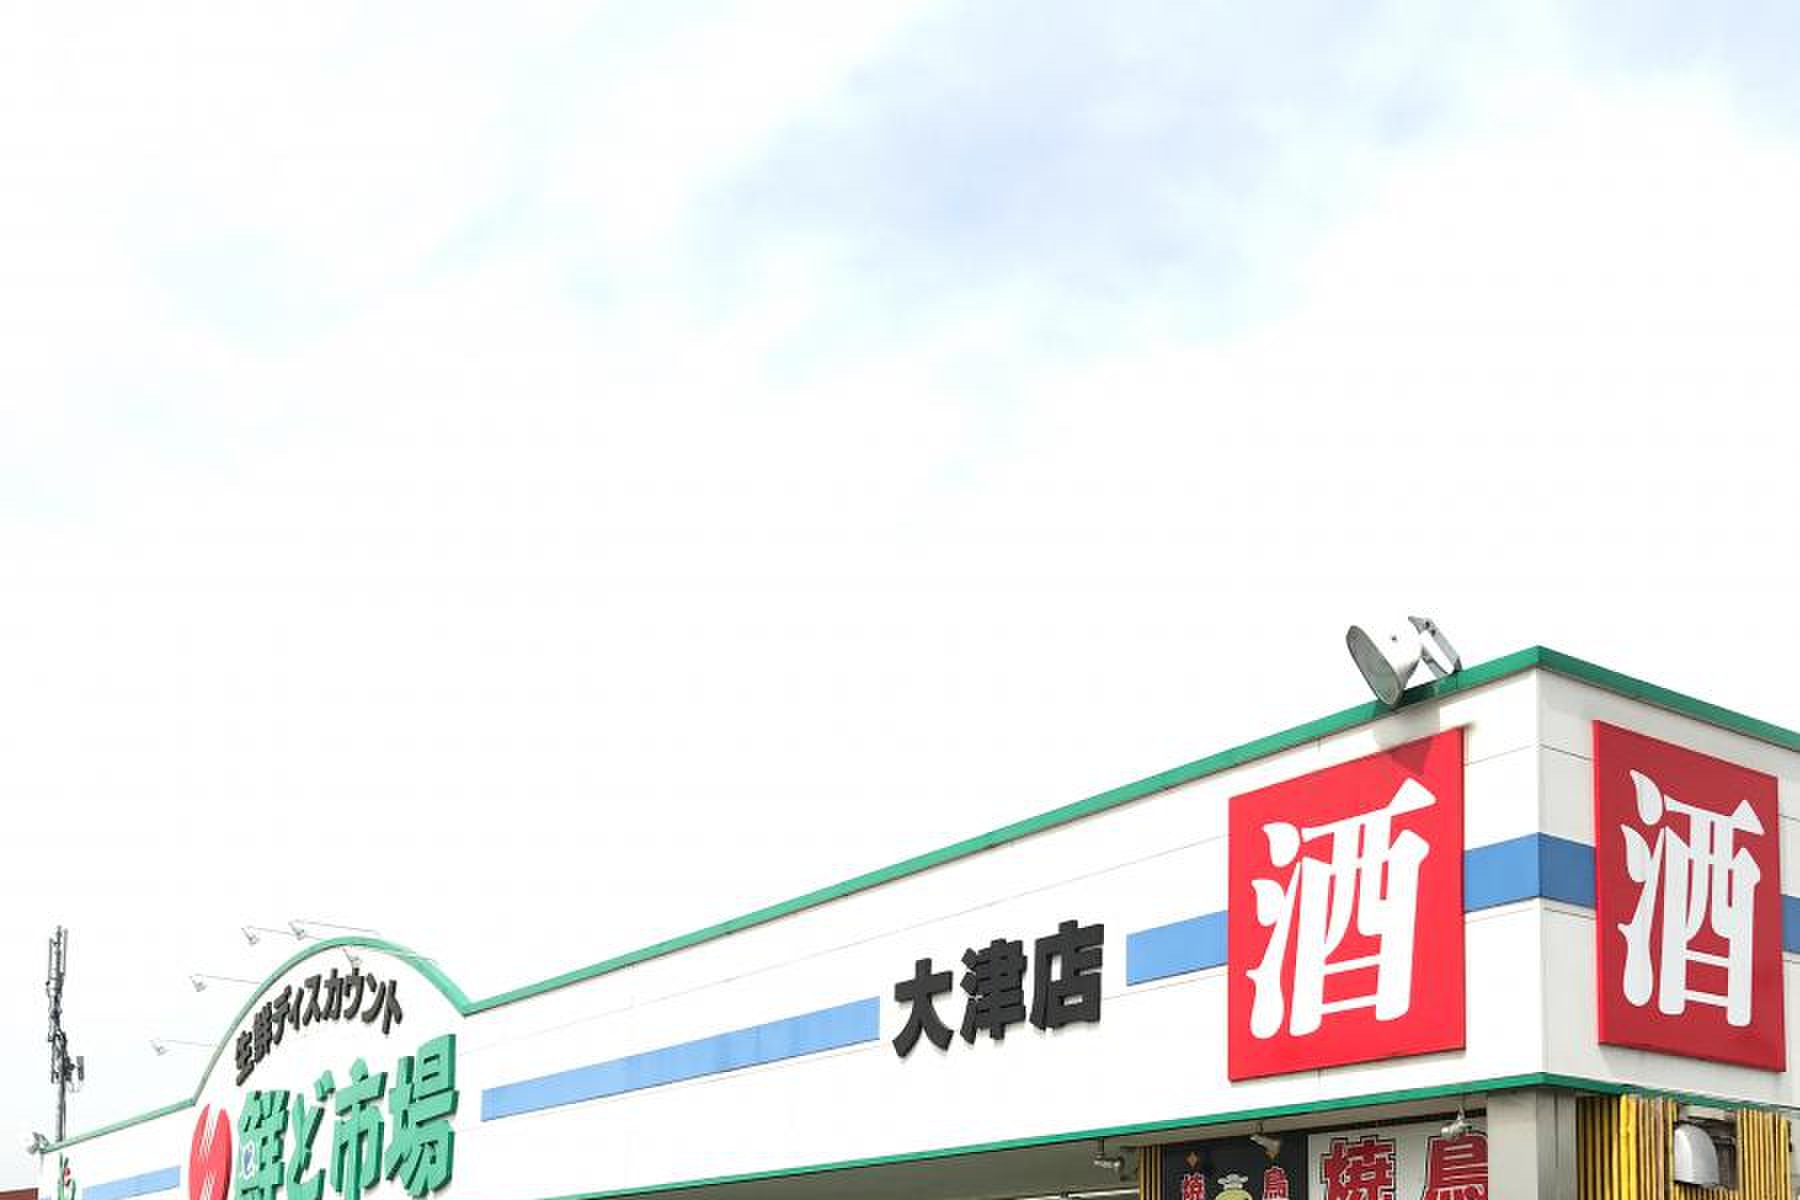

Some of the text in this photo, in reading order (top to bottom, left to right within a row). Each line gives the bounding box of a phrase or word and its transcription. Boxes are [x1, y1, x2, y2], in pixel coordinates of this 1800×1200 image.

[892, 919, 1104, 1058] 大津店
[1246, 777, 1436, 1040] 酒
[1617, 769, 1765, 1028] 酒
[235, 967, 402, 1086] 生鮮ディスカウント
